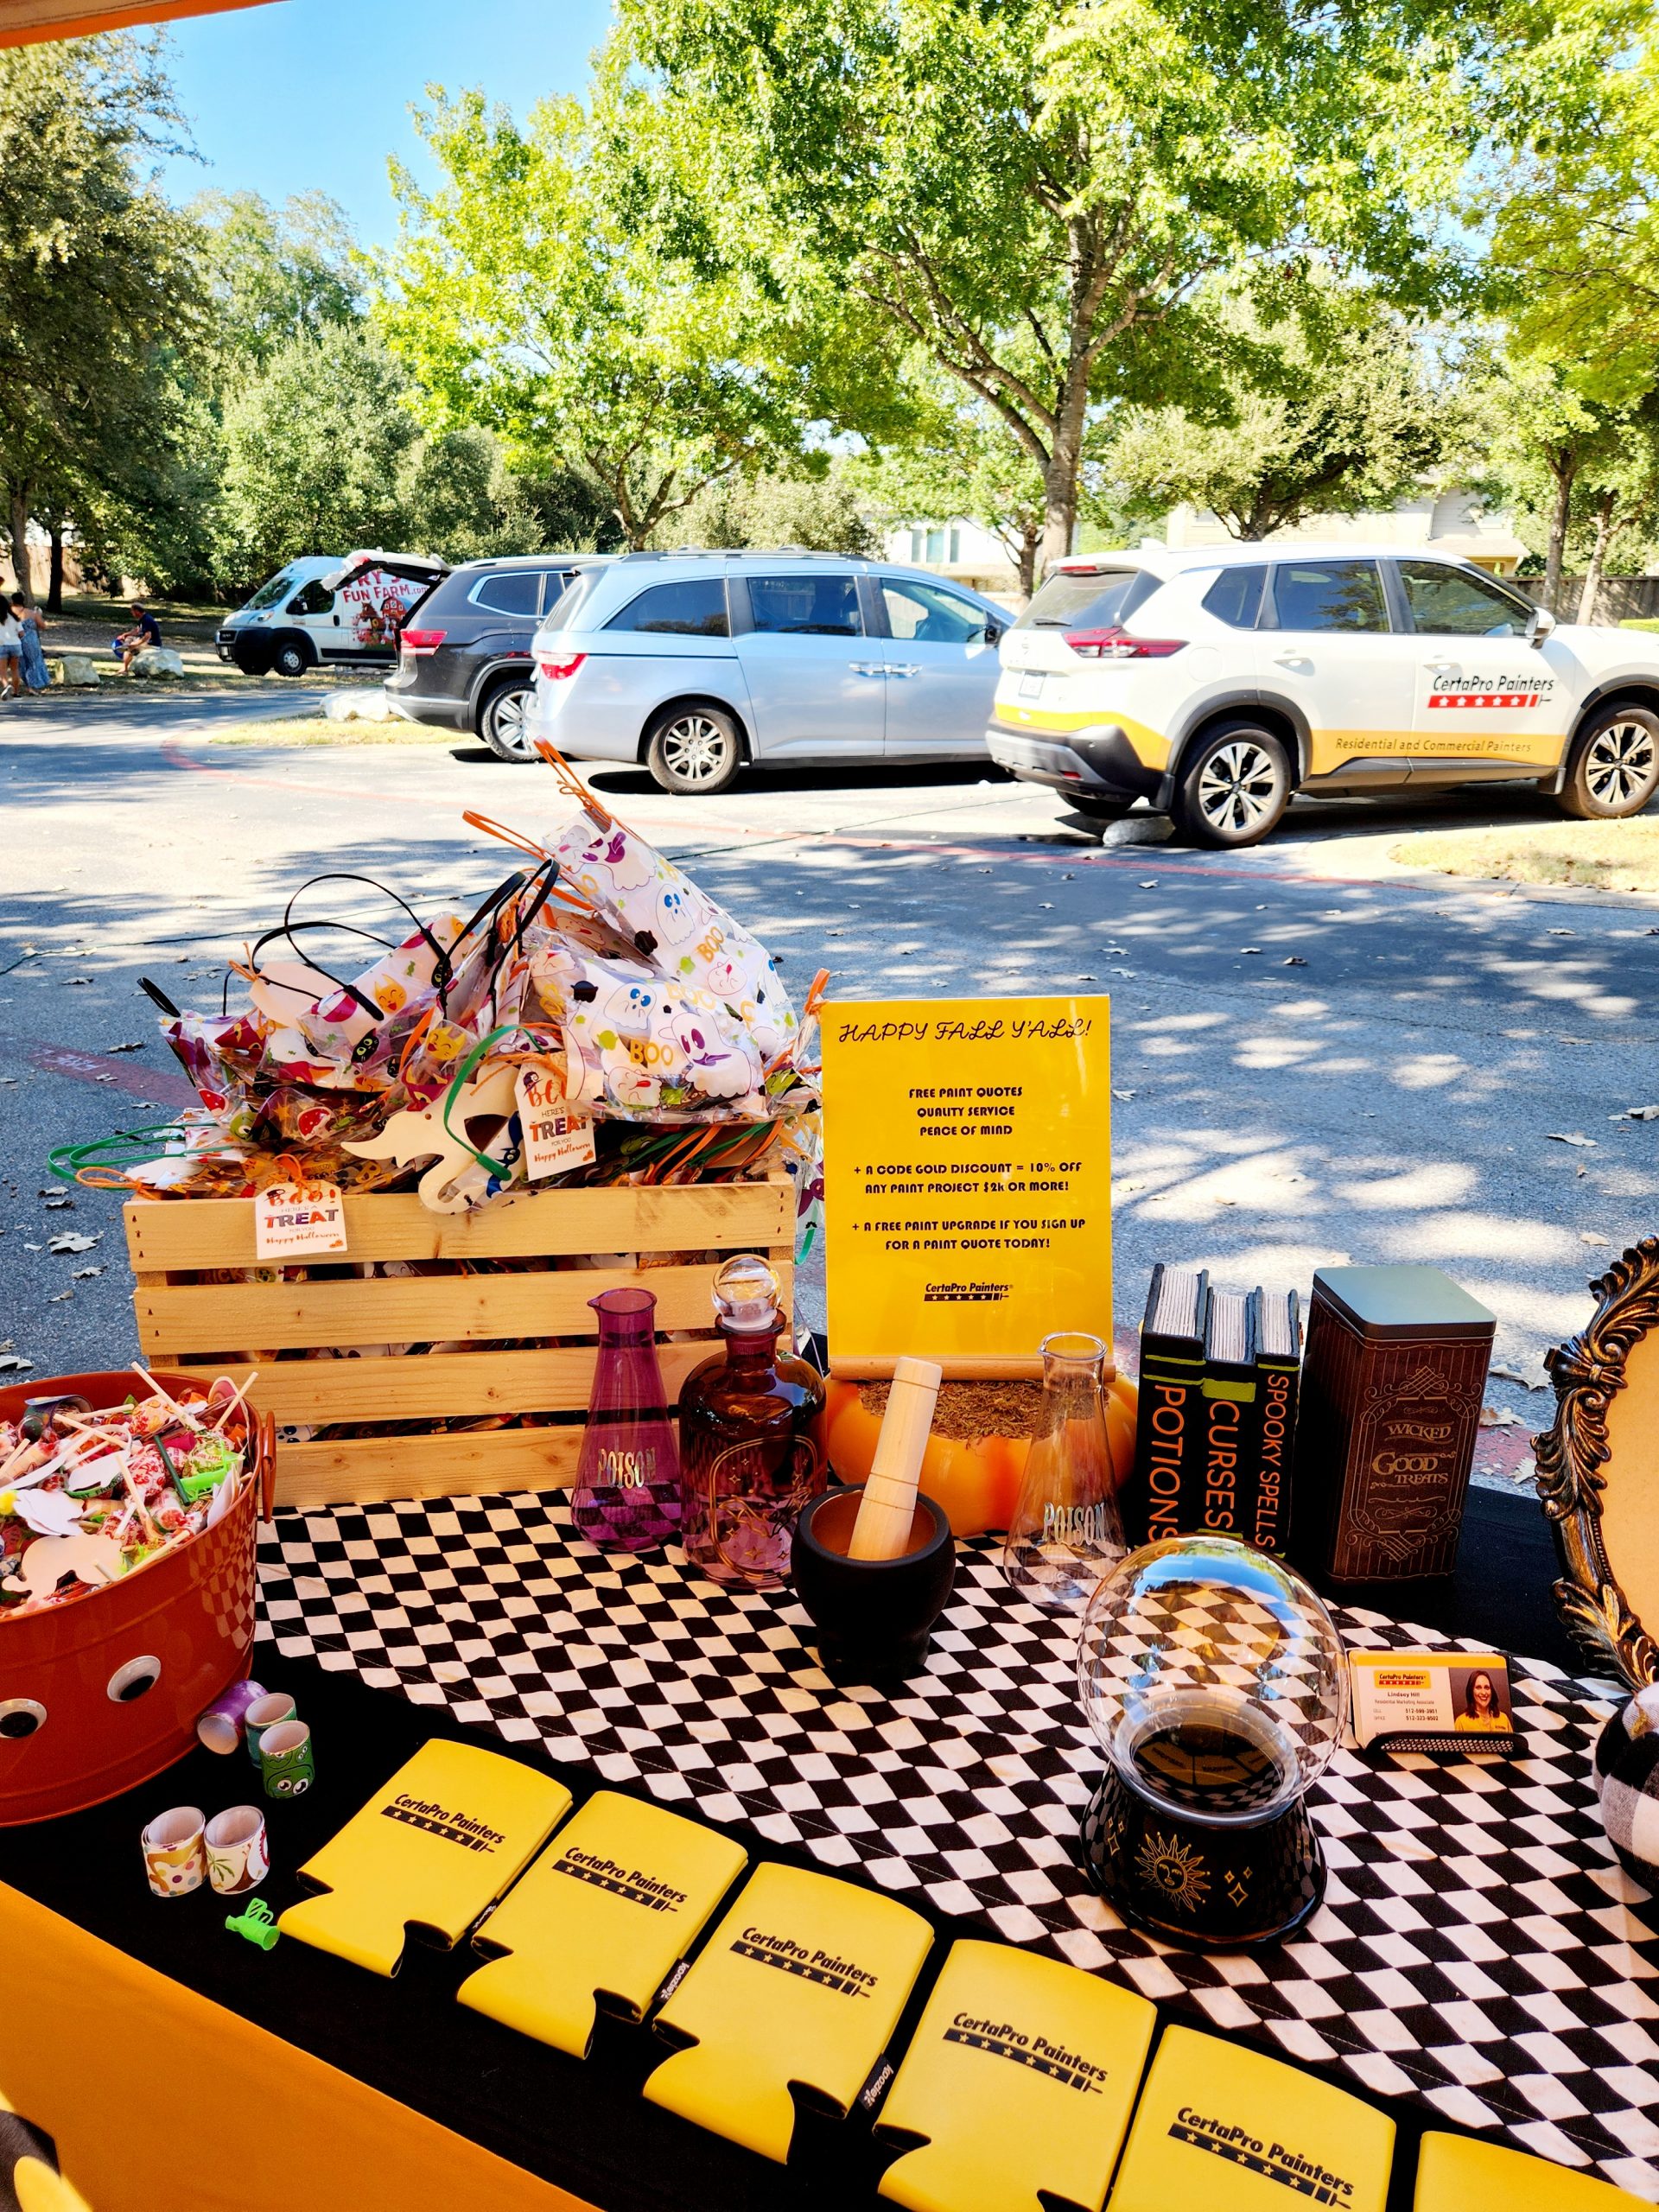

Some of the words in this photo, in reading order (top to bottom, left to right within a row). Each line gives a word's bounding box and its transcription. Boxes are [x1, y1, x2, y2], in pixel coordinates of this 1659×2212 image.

[343, 588, 371, 603] FUN
[1433, 675, 1493, 691] CertaPro
[1497, 675, 1554, 691] Painters
[1336, 738, 1397, 750] Residential
[1400, 739, 1420, 751] and
[1424, 740, 1485, 752] Commercial
[1487, 741, 1531, 753] Painters
[696, 926, 724, 963] BOO
[838, 1022, 928, 1043] HAPPY
[935, 1020, 1005, 1040] FALL
[1012, 1019, 1092, 1039] Y'ALL!
[630, 1039, 673, 1066] BOO
[909, 1088, 936, 1098] FREE
[939, 1087, 972, 1097] PAINT
[976, 1086, 1022, 1097] QUOTES
[917, 1107, 964, 1118] QUALITY
[968, 1106, 1014, 1116] SERVICE
[529, 1115, 589, 1141] TREAT
[919, 1126, 957, 1136] PEACE
[960, 1125, 977, 1135] OF
[980, 1125, 1013, 1135] MIND
[534, 1151, 556, 1163] Happy
[557, 1142, 591, 1156] Halloween
[866, 1165, 873, 1175] A
[876, 1165, 912, 1175] CODE
[915, 1164, 947, 1174] GOLD
[950, 1163, 1012, 1174] DISCOUNT
[1029, 1162, 1055, 1173] 10%
[1058, 1161, 1083, 1173] OFF
[865, 1183, 887, 1194] ANY
[890, 1183, 924, 1193] PAINT
[927, 1182, 979, 1193] PROJECT
[983, 1182, 1005, 1193] $2k
[1007, 1182, 1026, 1192] OR
[1029, 1181, 1069, 1192] MORE!
[264, 1209, 339, 1228] TREAT
[864, 1222, 872, 1231] A
[875, 1221, 902, 1231] FREE
[905, 1221, 938, 1231] PAINT
[942, 1220, 995, 1230] UPGRADE
[999, 1219, 1009, 1230] IF
[1013, 1219, 1039, 1230] YOU
[1041, 1218, 1067, 1230] SIGN
[1070, 1218, 1086, 1229] UP
[296, 1231, 339, 1241] Halloween
[886, 1240, 909, 1250] FOR
[912, 1240, 920, 1249] A
[924, 1239, 957, 1249] PAINT
[961, 1239, 1001, 1250] QUOTE
[1004, 1238, 1050, 1249] TODAY!
[925, 1283, 967, 1293] CertaPro
[969, 1282, 1009, 1293] Painters
[1262, 1374, 1289, 1466] SPOOKY
[1388, 1423, 1452, 1440] WICKED
[597, 1446, 656, 1489] POISON
[1148, 1385, 1185, 1542] POTIONS
[1205, 1401, 1240, 1529] CURSES
[1371, 1452, 1439, 1476] GOOD
[1395, 1473, 1449, 1485] TREATS
[1255, 1471, 1281, 1548] SPELLS
[1042, 1502, 1106, 1547] POISON
[395, 1794, 449, 1820] CertaPro
[449, 1813, 505, 1844] Painters
[565, 1847, 626, 1878] CertaPro
[626, 1871, 688, 1903] Painters
[742, 1927, 809, 1959] CertaPro
[810, 1949, 878, 1986] Painters
[666, 1962, 690, 1993] koozie
[953, 2012, 1029, 2046] CertaPro
[1032, 2036, 1108, 2082] Painters
[870, 2064, 893, 2098] koozie
[1178, 2107, 1264, 2152] CertaPro
[1268, 2143, 1354, 2196] Painters
